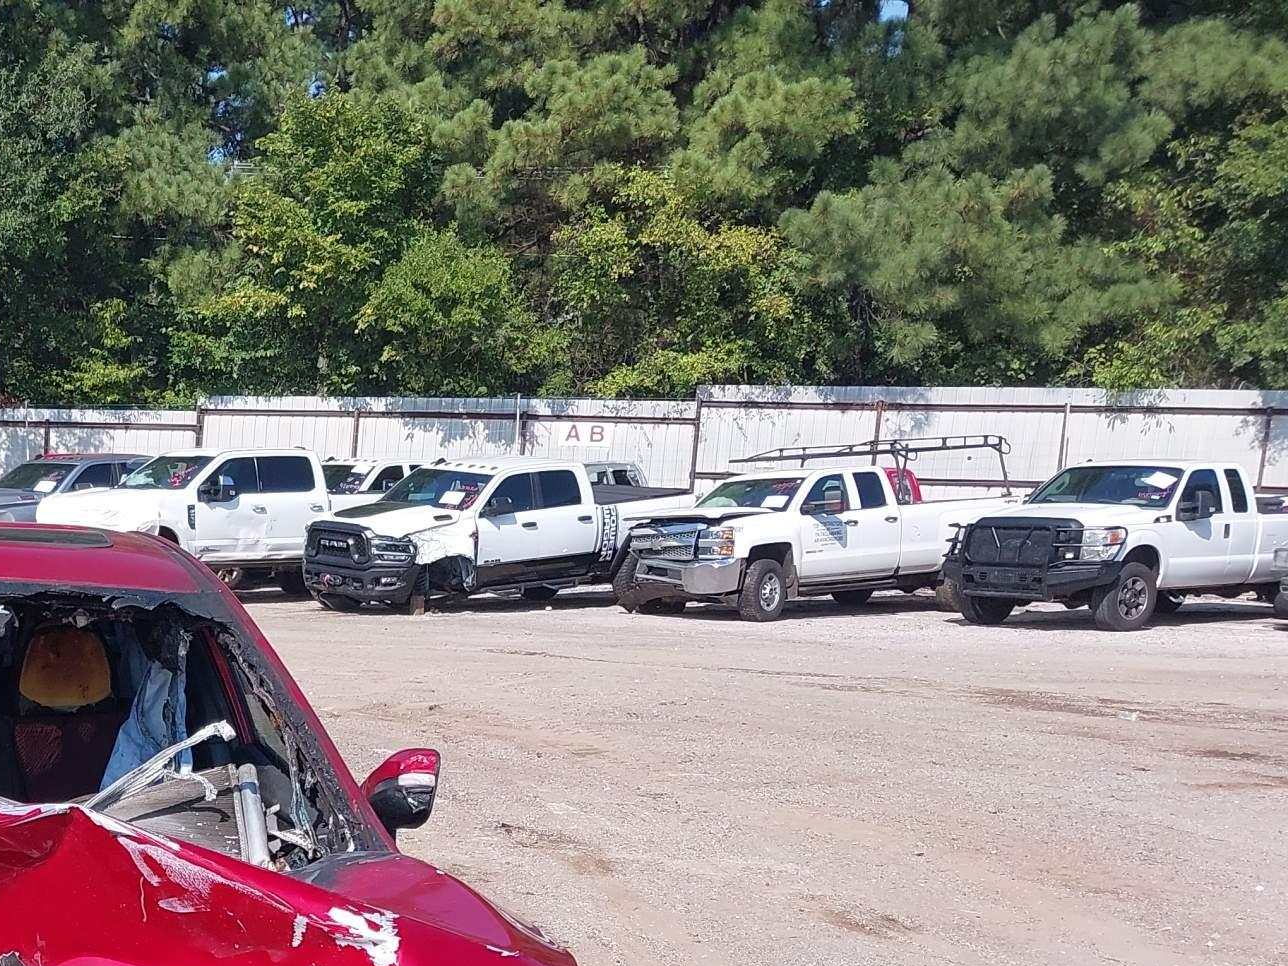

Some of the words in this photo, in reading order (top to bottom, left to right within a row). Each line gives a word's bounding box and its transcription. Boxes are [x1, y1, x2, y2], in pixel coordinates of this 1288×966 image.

[565, 424, 580, 442] A
[590, 425, 604, 442] B
[607, 505, 617, 561] POWER
[320, 539, 347, 548] RAM
